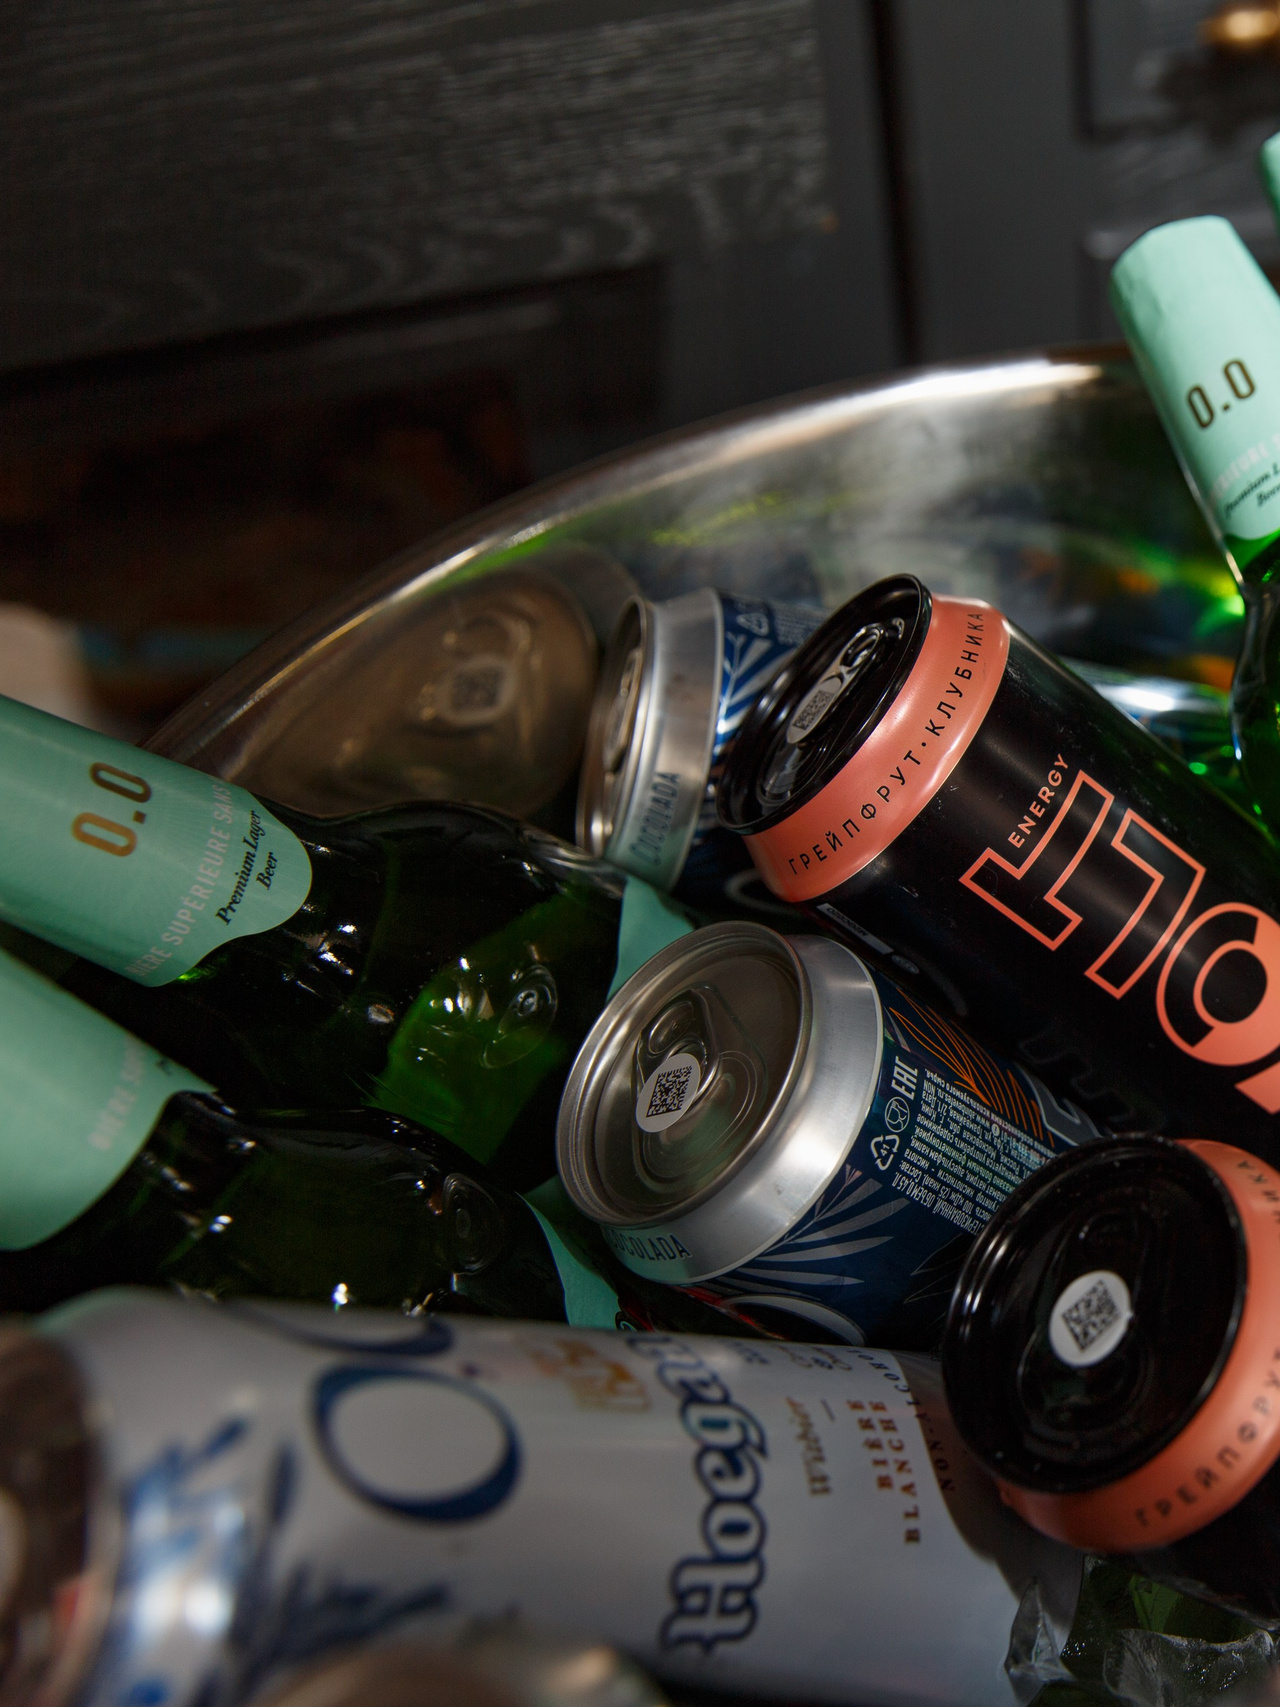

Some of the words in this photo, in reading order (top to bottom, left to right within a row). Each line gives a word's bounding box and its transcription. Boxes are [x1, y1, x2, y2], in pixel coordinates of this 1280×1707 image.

[1184, 358, 1257, 430] 0.0
[71, 762, 152, 858] 0.0
[1009, 752, 1070, 849] ENERGY
[161, 826, 231, 944] SUPÉRIEURE
[212, 784, 231, 823] SANS
[215, 848, 258, 925] Premium
[246, 810, 266, 851] Lager
[254, 850, 279, 889] Beer
[919, 1079, 939, 1095] NON
[921, 1067, 948, 1086] сырья.
[918, 1089, 939, 1106] Дата
[915, 1101, 939, 1120] Клин,
[914, 1113, 956, 1141] содержимое
[906, 1136, 931, 1154] калия,
[961, 1129, 996, 1159] Московская
[896, 1160, 923, 1181] Состав:
[902, 1149, 930, 1169] кислота
[936, 1168, 975, 1197] кислотности
[937, 1184, 952, 1199] (25
[909, 1184, 935, 1207] ОБЪЕМ
[946, 1189, 966, 1207] кДж
[960, 1200, 976, 1214] 100
[868, 1400, 922, 1544] BLANCHE
